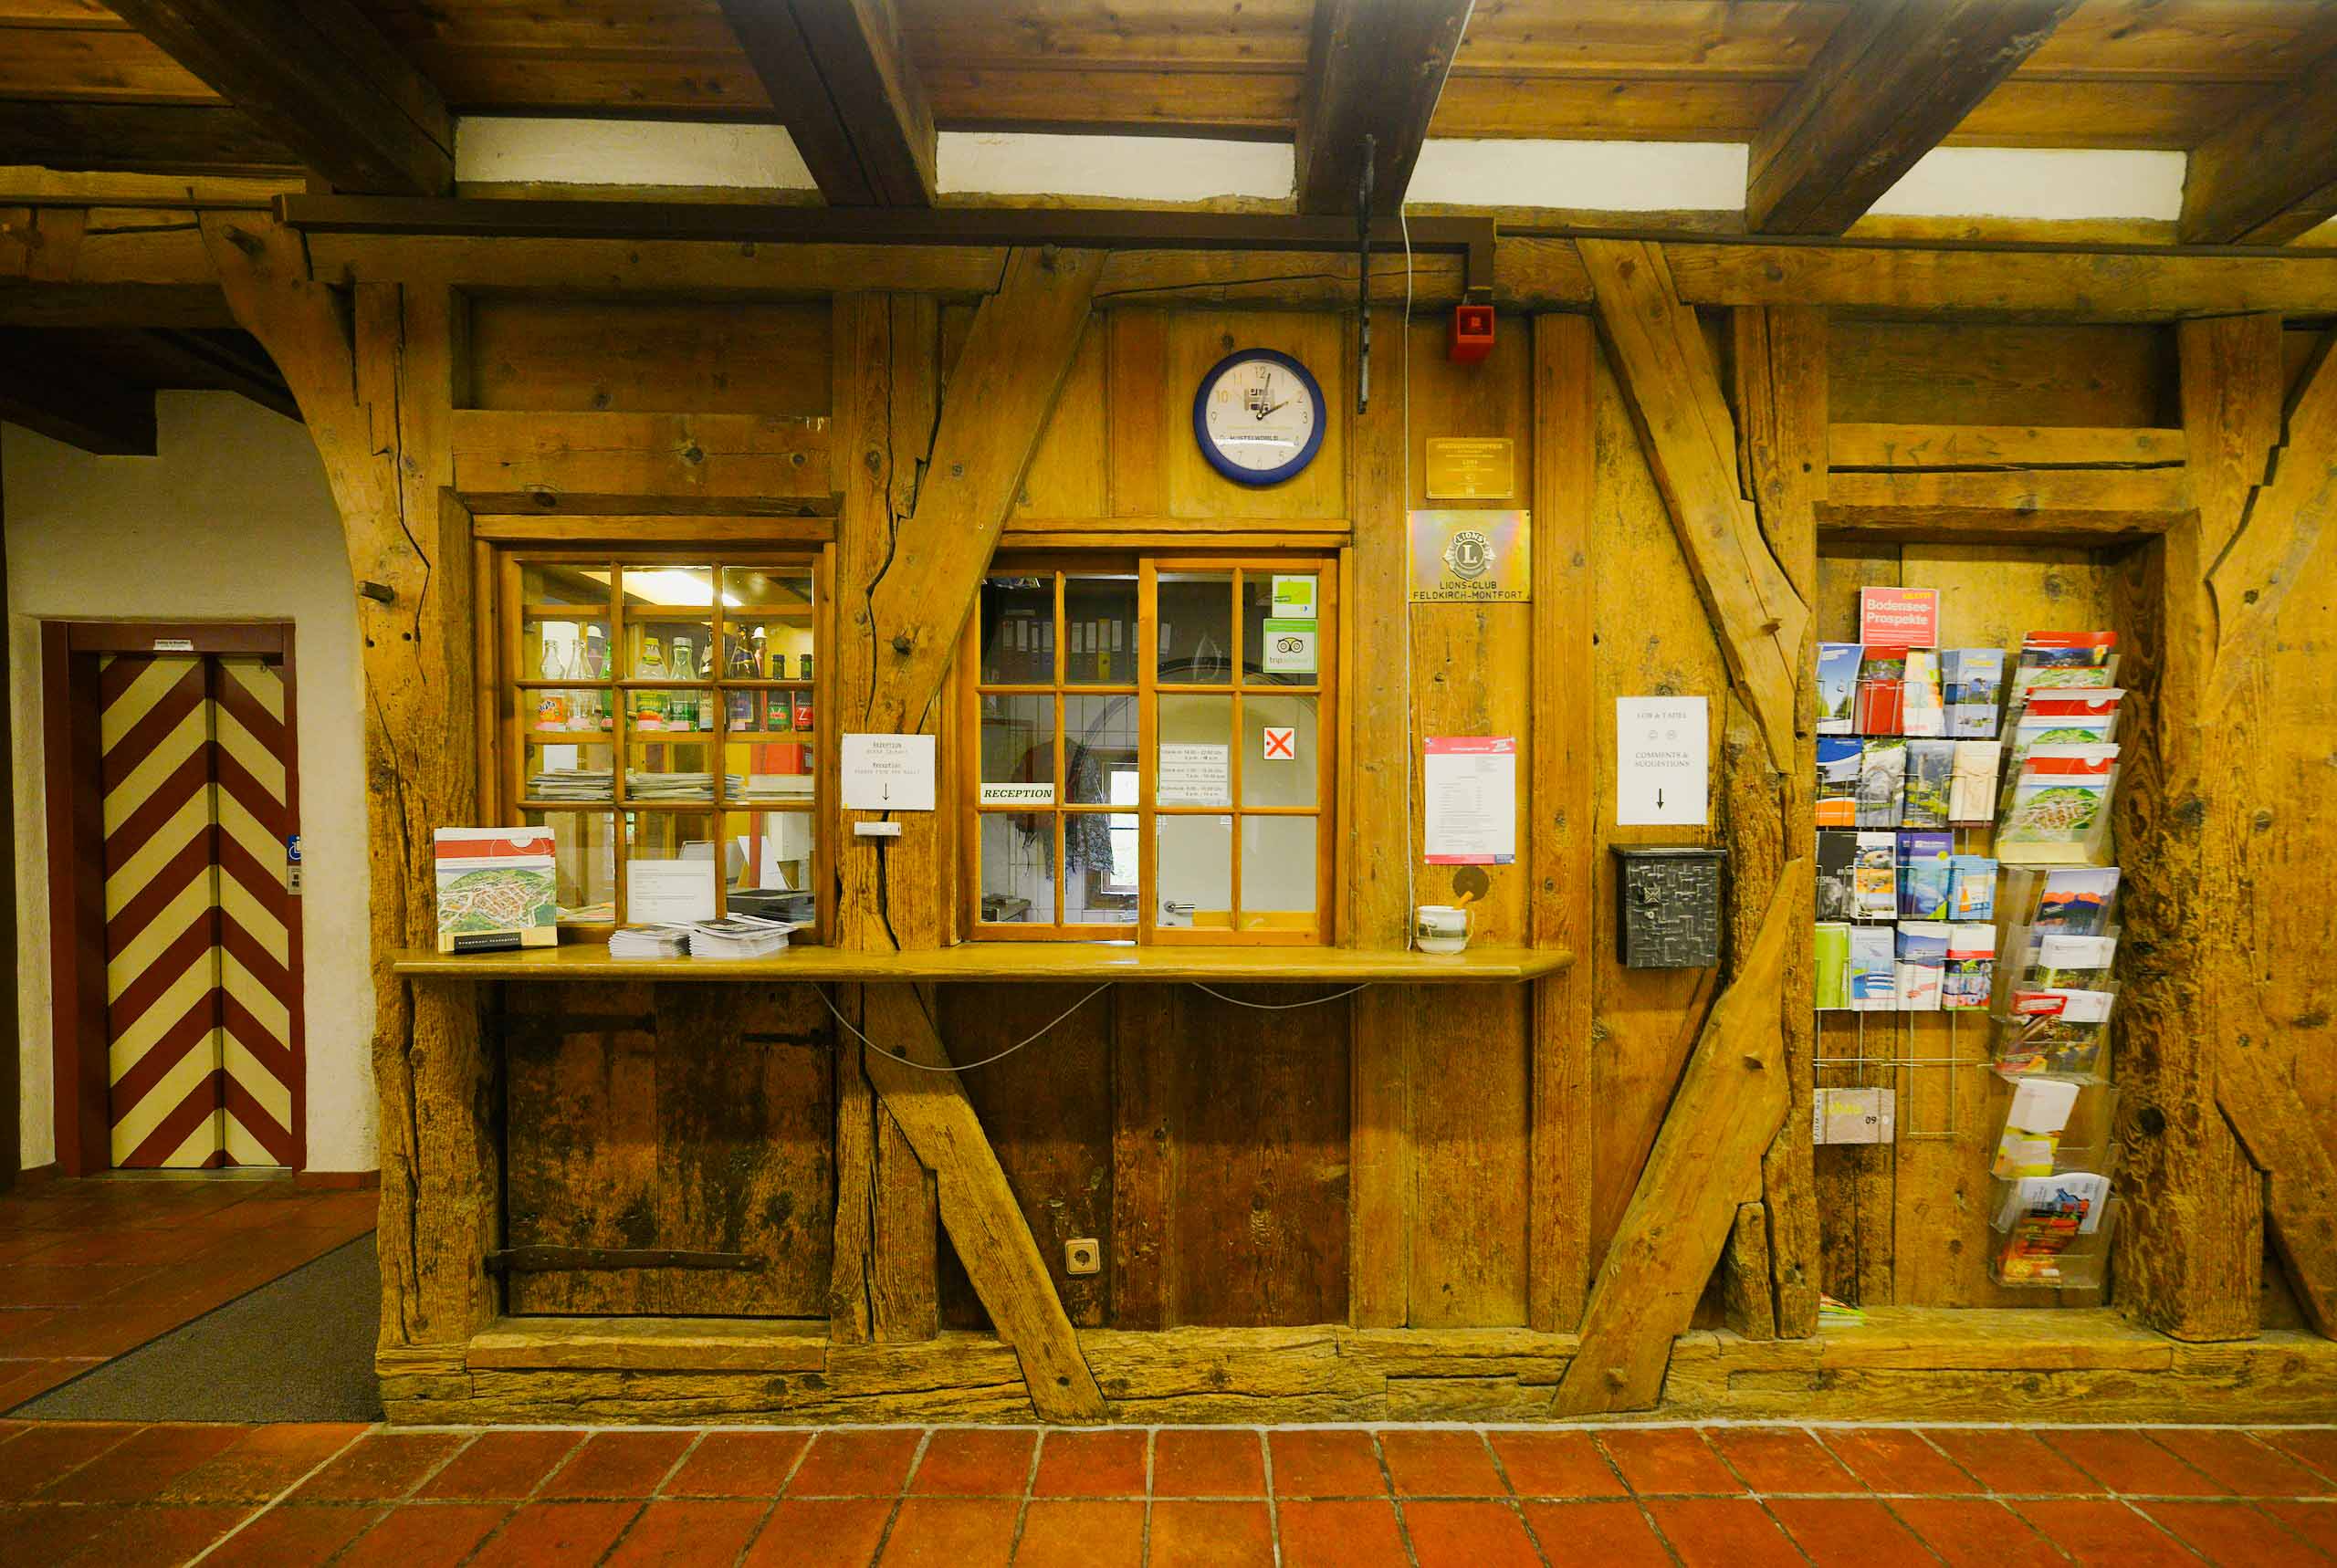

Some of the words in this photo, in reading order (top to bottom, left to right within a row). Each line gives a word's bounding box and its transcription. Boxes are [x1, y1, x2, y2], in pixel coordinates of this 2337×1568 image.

[1255, 366, 1266, 379] 12
[1233, 372, 1242, 387] 11
[1216, 390, 1229, 403] 10
[1297, 391, 1304, 403] 2
[1210, 412, 1217, 424] 9
[1302, 412, 1308, 424] 3
[1457, 532, 1483, 543] LIONS
[1462, 544, 1478, 564] L
[1440, 581, 1497, 590] LIONS-CLUB
[1413, 591, 1523, 600] FELDKIRCH-MONTFORT
[1867, 599, 1933, 612] Bodensee-
[1867, 612, 1928, 625] Prospekte
[984, 789, 1052, 798] RECEPTION
